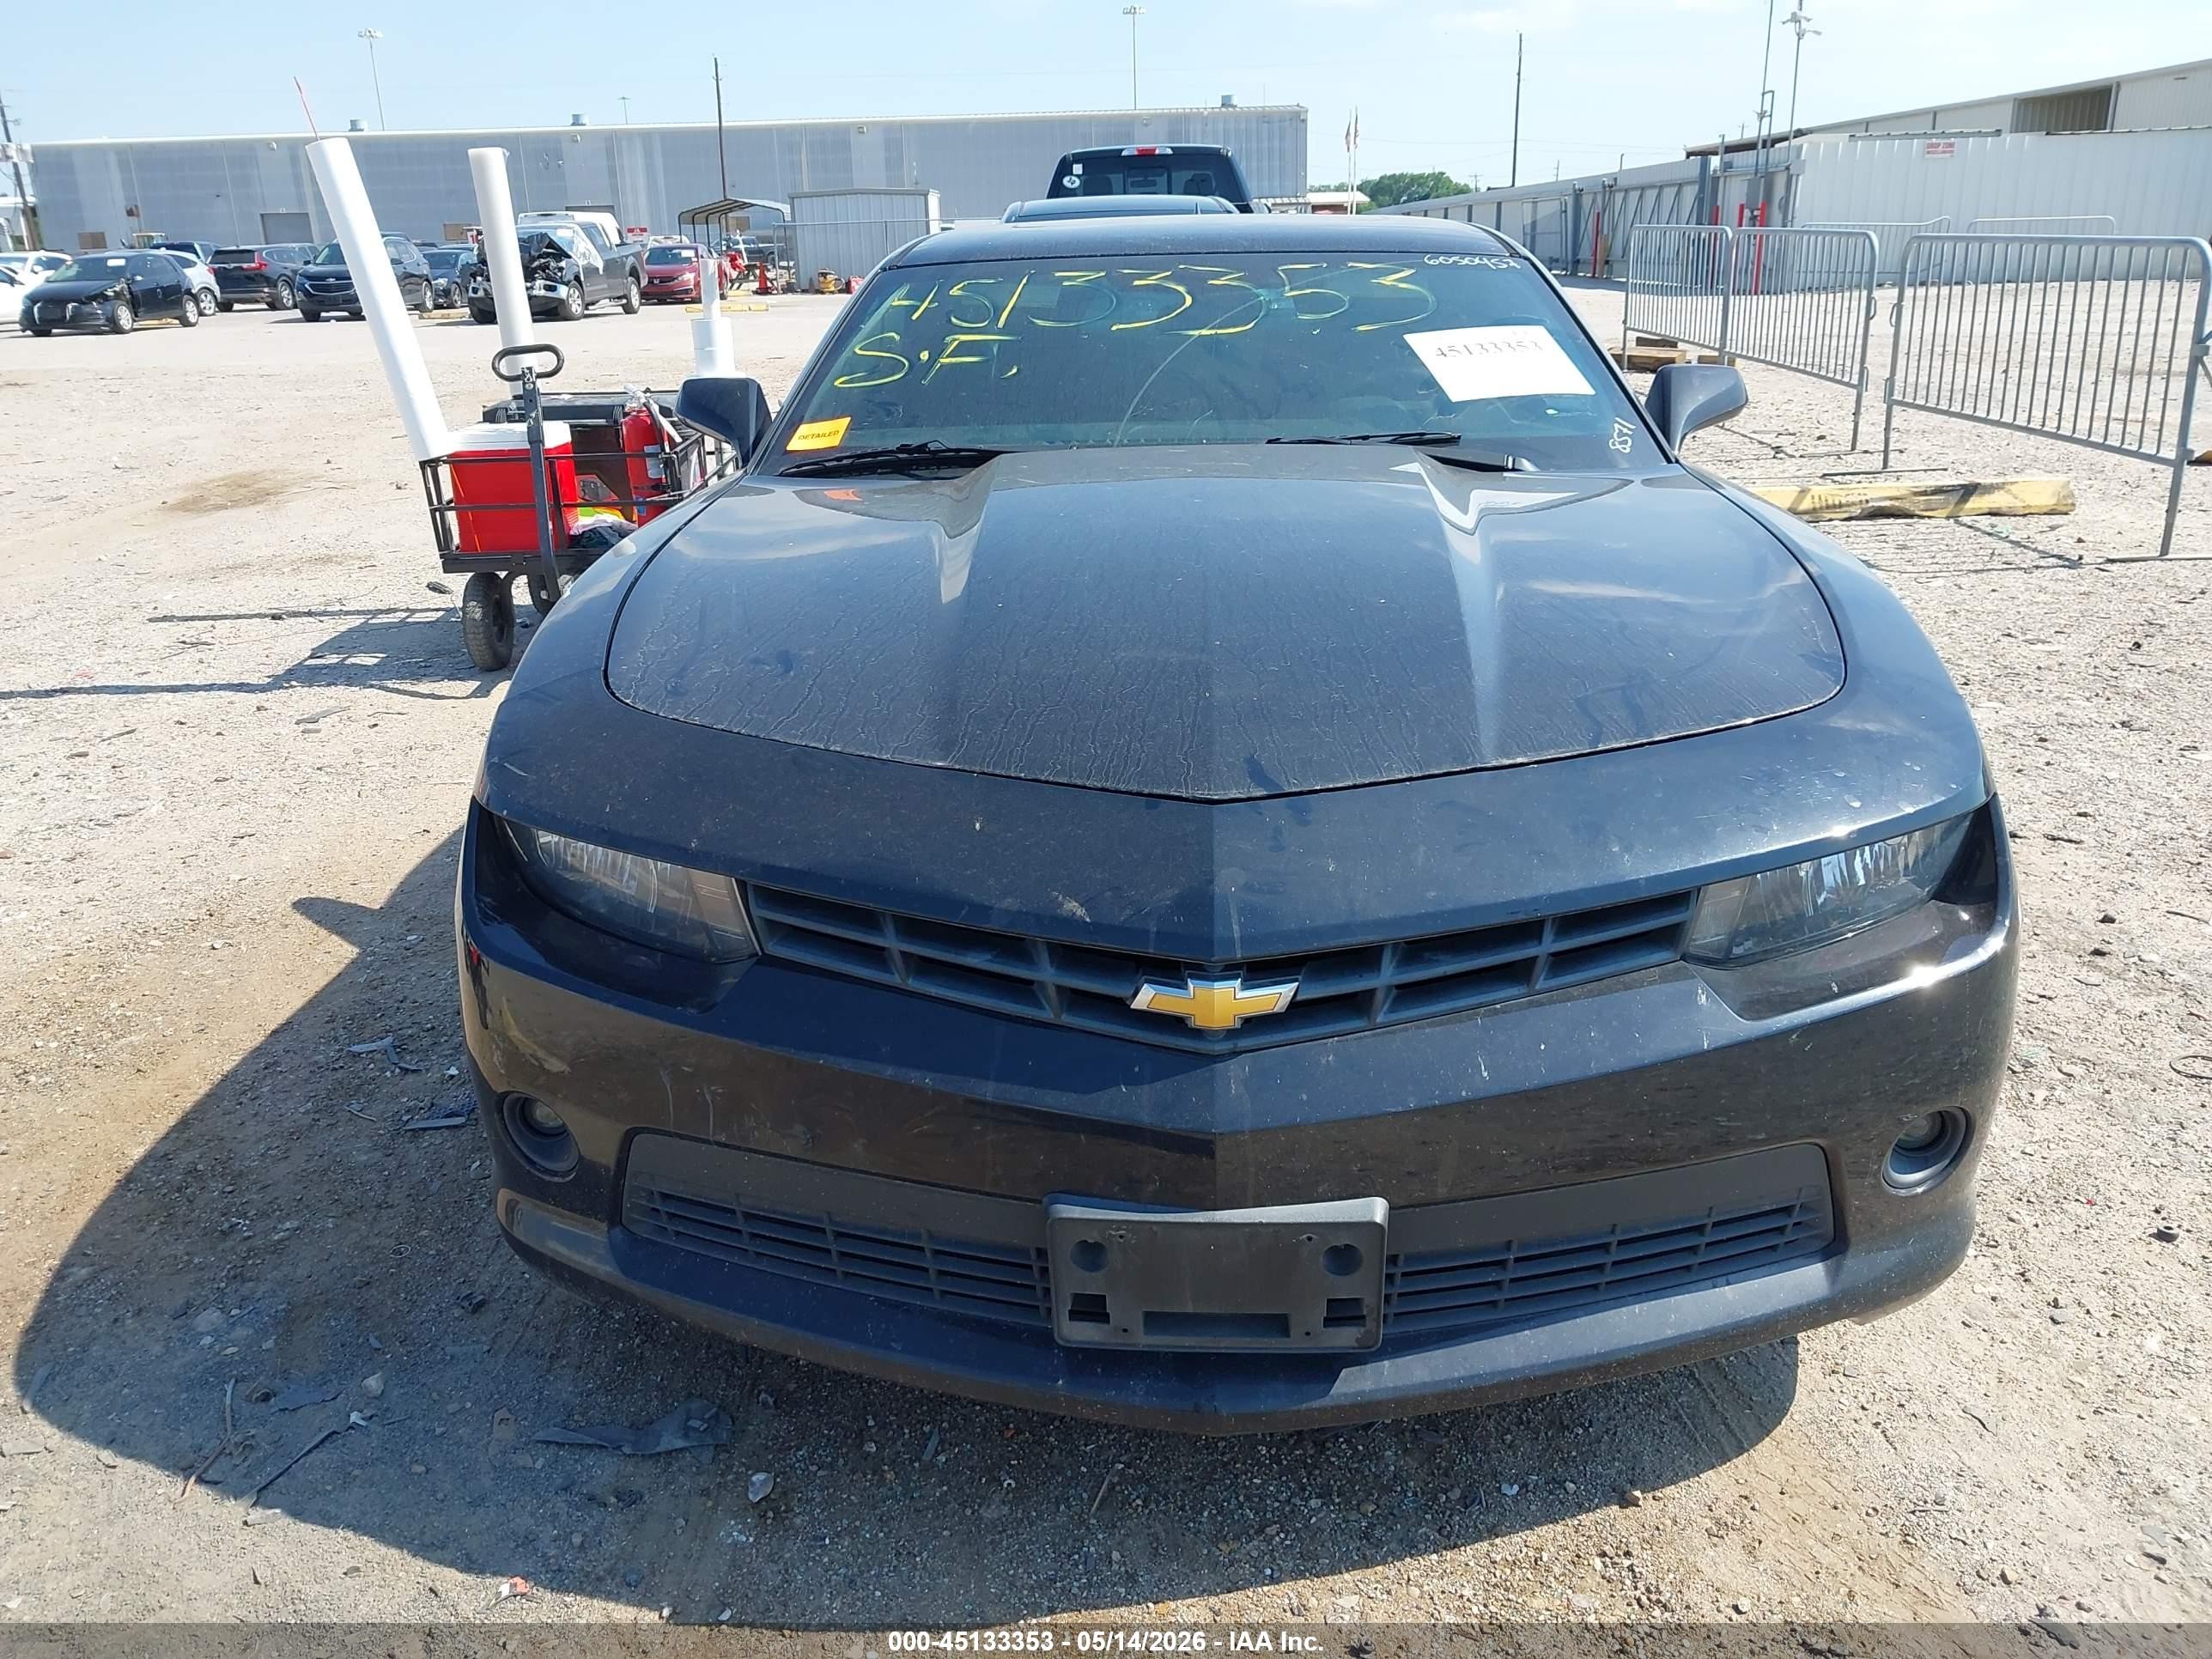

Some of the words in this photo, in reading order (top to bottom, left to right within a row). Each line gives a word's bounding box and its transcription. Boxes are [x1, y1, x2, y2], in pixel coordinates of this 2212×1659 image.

[891, 262, 1437, 335] 45133353
[1435, 340, 1544, 358] 45133353
[798, 429, 840, 441] DETAILED
